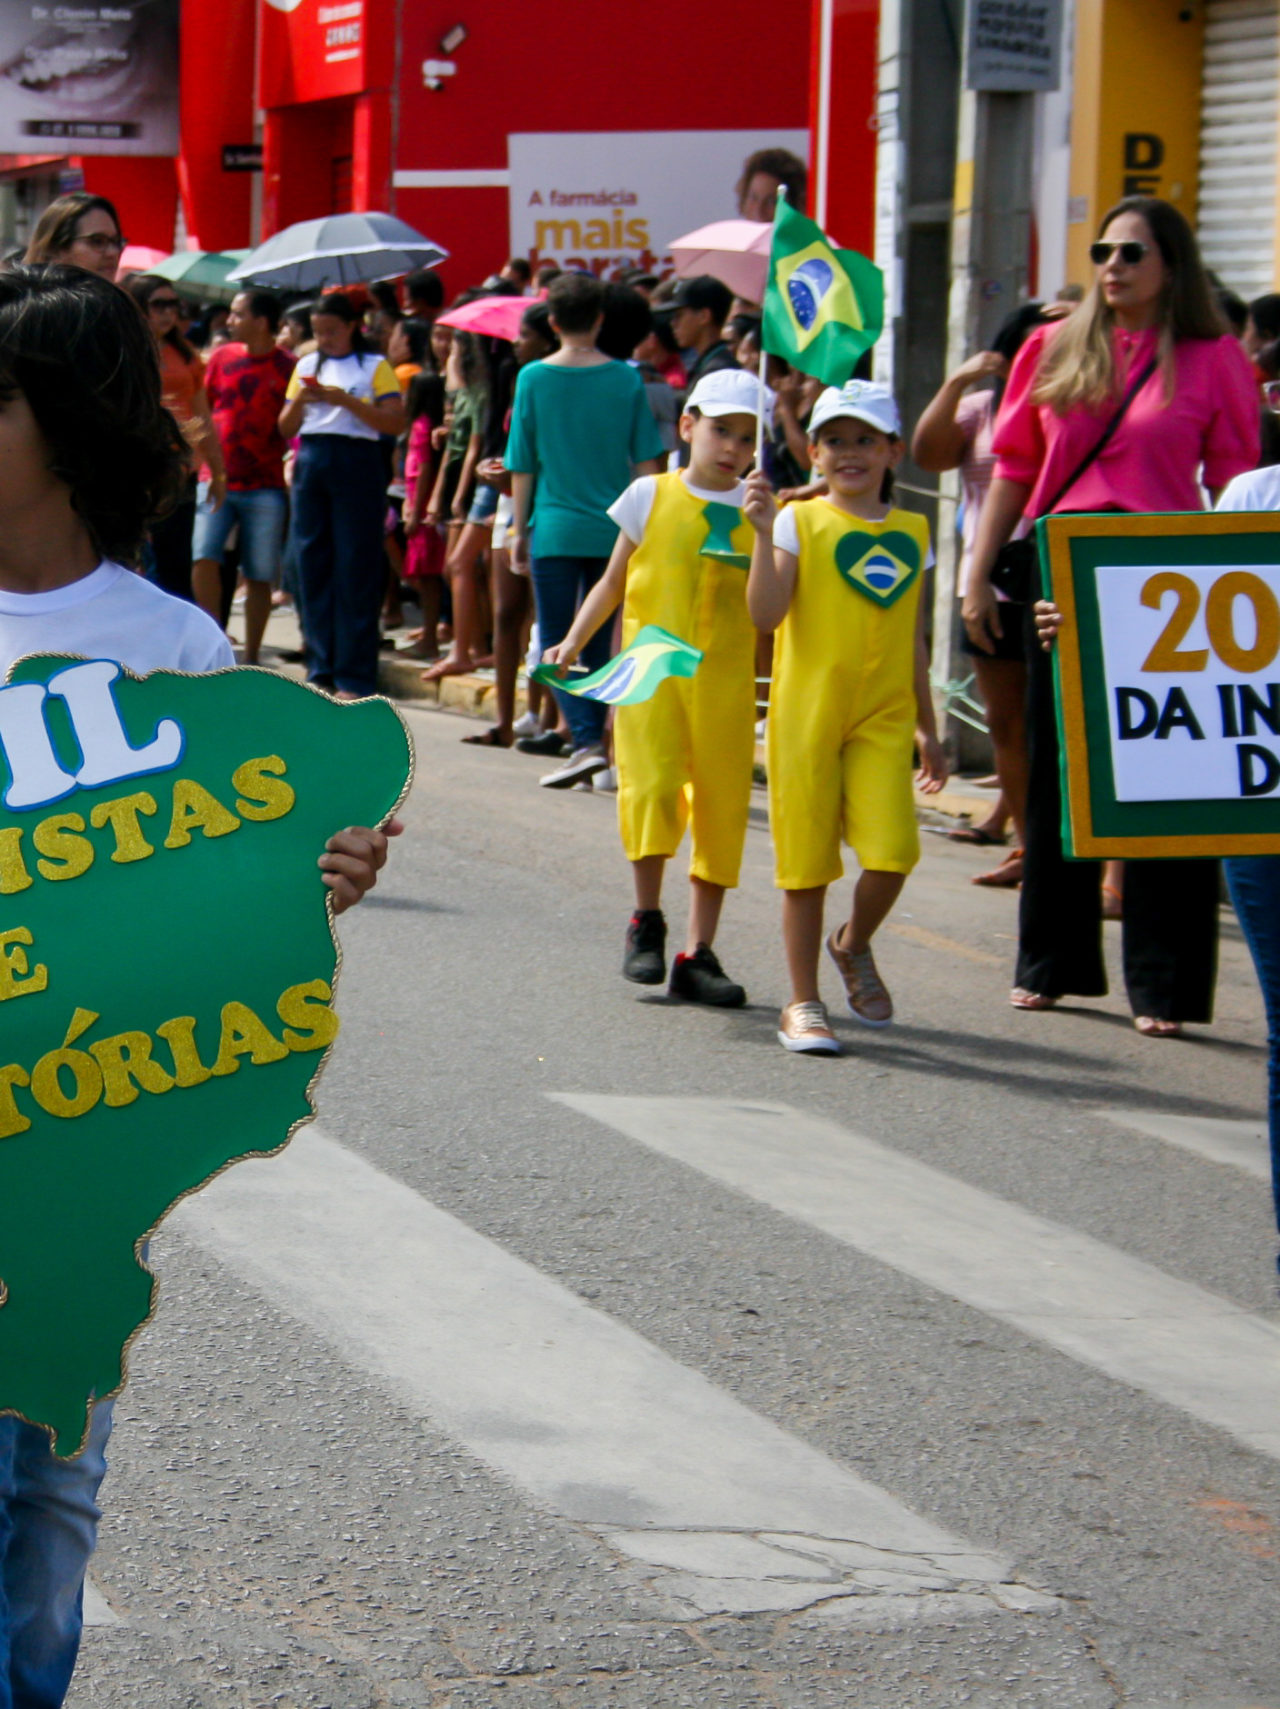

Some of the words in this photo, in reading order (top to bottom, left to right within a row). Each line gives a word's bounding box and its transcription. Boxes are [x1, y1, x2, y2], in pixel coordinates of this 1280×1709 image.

[528, 189, 543, 207] A
[549, 188, 638, 207] farmácia
[534, 208, 650, 251] mais
[1115, 686, 1206, 741] DA
